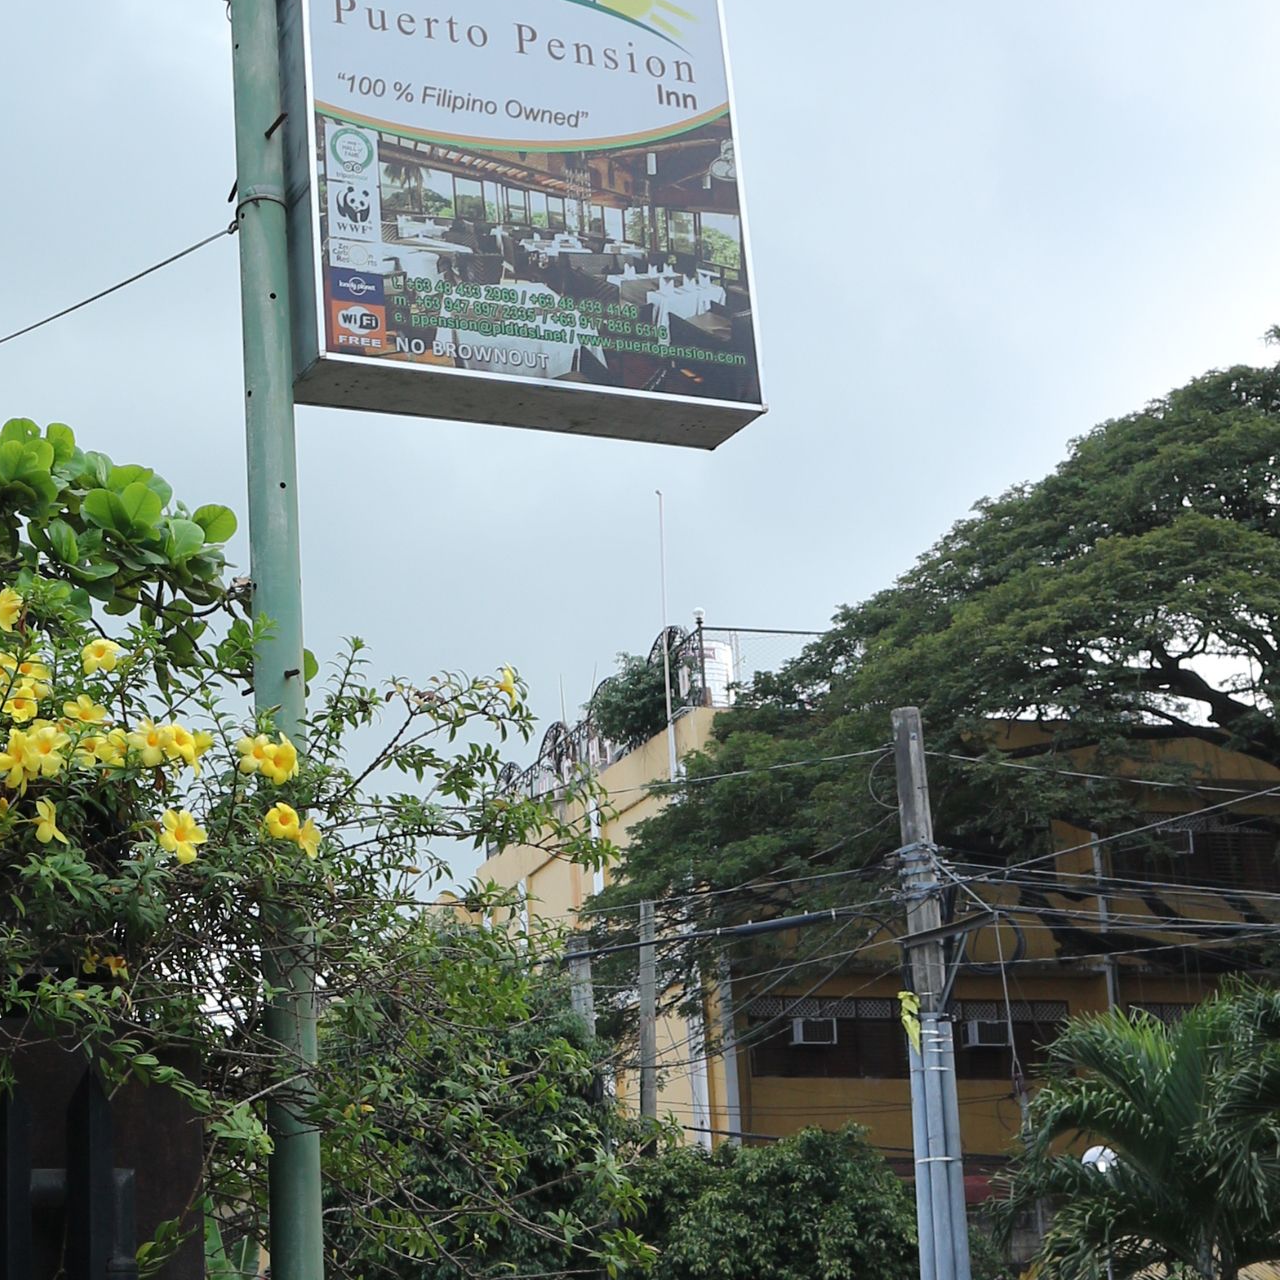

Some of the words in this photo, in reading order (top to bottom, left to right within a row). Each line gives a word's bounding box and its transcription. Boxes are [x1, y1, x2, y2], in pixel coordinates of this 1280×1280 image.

[513, 22, 696, 84] Pension
[393, 81, 414, 103] %
[422, 85, 498, 116] Filipino
[656, 84, 698, 110] Inn
[337, 222, 369, 234] WWF
[408, 277, 432, 293] +63
[435, 280, 452, 295] 48
[456, 283, 482, 299] 433
[484, 286, 518, 303] 2969
[530, 293, 555, 308] +63
[558, 297, 574, 310] 48
[578, 299, 602, 314] 433
[607, 303, 638, 319] 4148
[416, 296, 441, 311] +63
[444, 299, 470, 314] 947
[474, 302, 498, 318] 897
[503, 306, 536, 322] 2335
[551, 313, 576, 328] +63
[579, 316, 602, 330] 917
[608, 318, 632, 334] 836
[636, 323, 668, 340] 6316
[338, 335, 382, 348] FREE
[396, 336, 425, 355] NO
[432, 340, 549, 369] BROWNOUT
[412, 313, 567, 344] ppension@pldtdsl.net
[576, 333, 746, 365] www.puertopension.com
